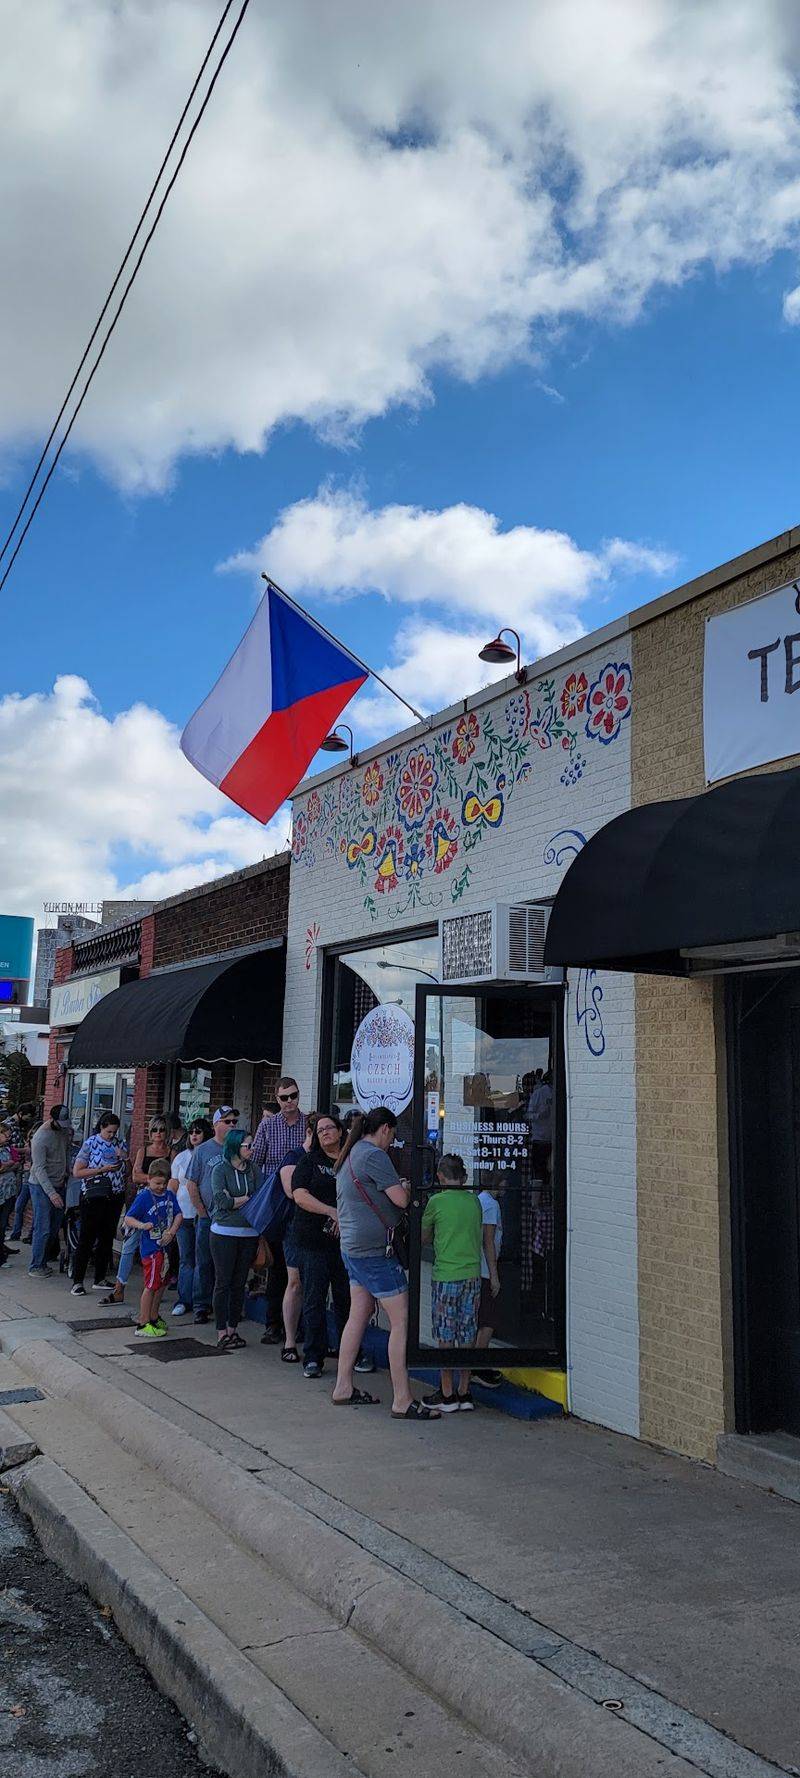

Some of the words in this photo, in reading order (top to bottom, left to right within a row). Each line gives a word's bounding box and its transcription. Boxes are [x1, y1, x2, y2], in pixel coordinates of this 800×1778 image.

[748, 632, 800, 703] TE
[43, 902, 73, 913] YUKON
[75, 902, 103, 914] MILLS
[367, 1063, 400, 1075] CZECH
[449, 1122, 494, 1132] BUSINESS
[496, 1122, 530, 1132] HOURS:
[504, 1147, 511, 1158] &
[512, 1147, 528, 1158] 4-8
[463, 1160, 494, 1171] Sunday
[497, 1160, 517, 1171] 10-4
